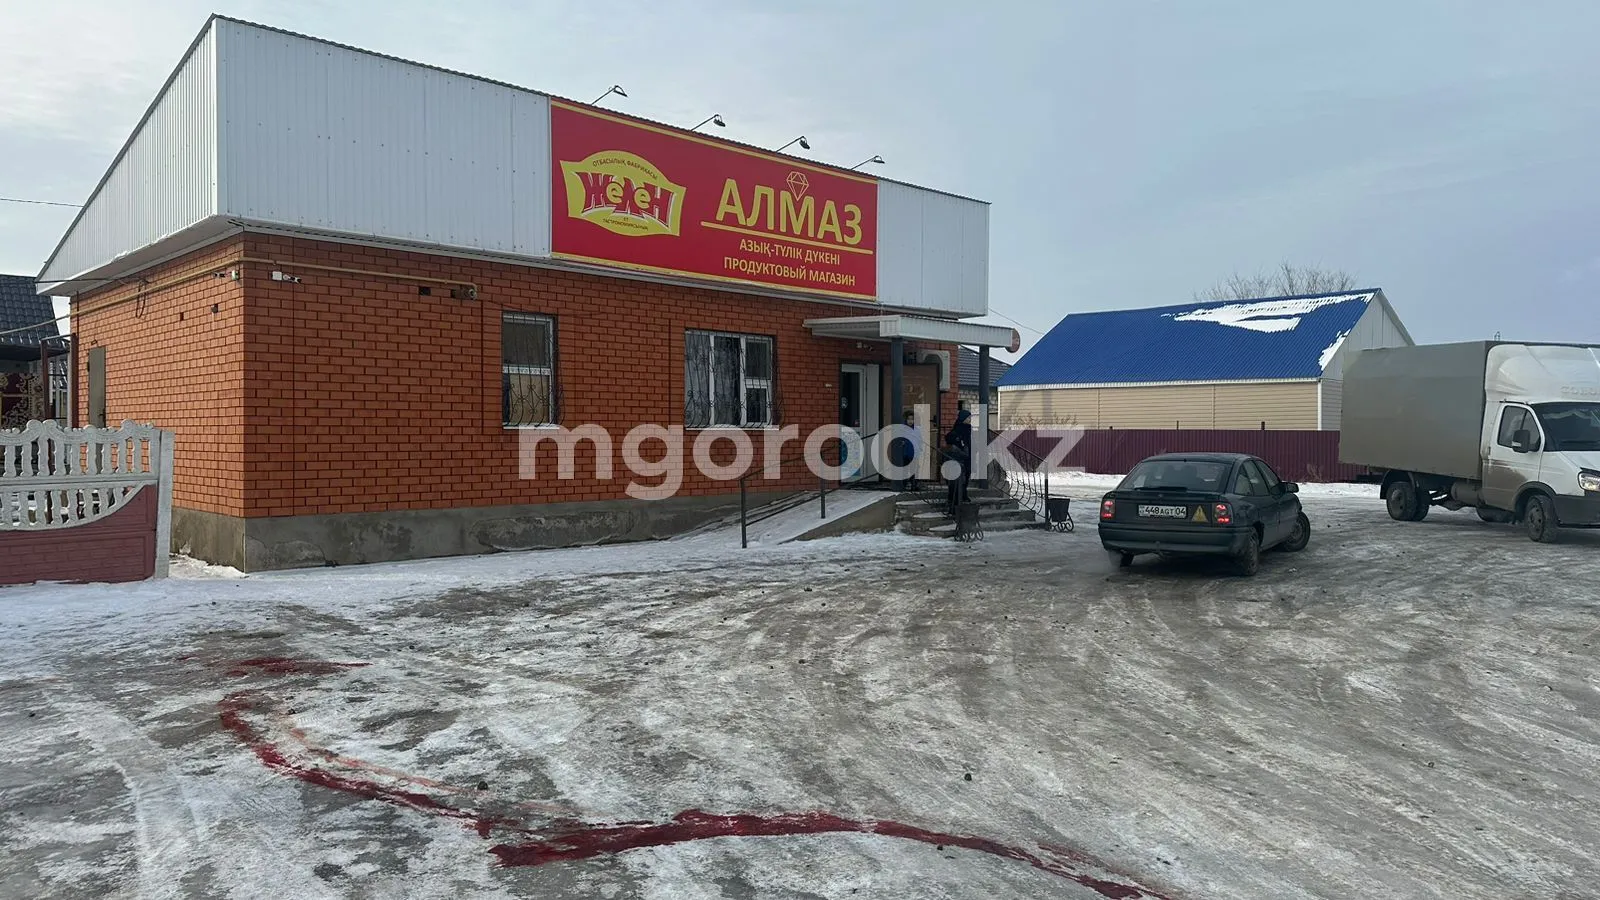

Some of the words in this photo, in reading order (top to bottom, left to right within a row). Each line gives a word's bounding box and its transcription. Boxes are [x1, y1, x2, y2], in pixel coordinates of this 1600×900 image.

[715, 178, 863, 245] АЛМАЗ
[739, 238, 803, 258] АЗЫҚ-ТҮЛІК
[804, 249, 840, 265] ДҮКЕНІ
[724, 256, 807, 280] ПРОДУКТОВЫЙ
[809, 270, 856, 286] МАГАЗИН
